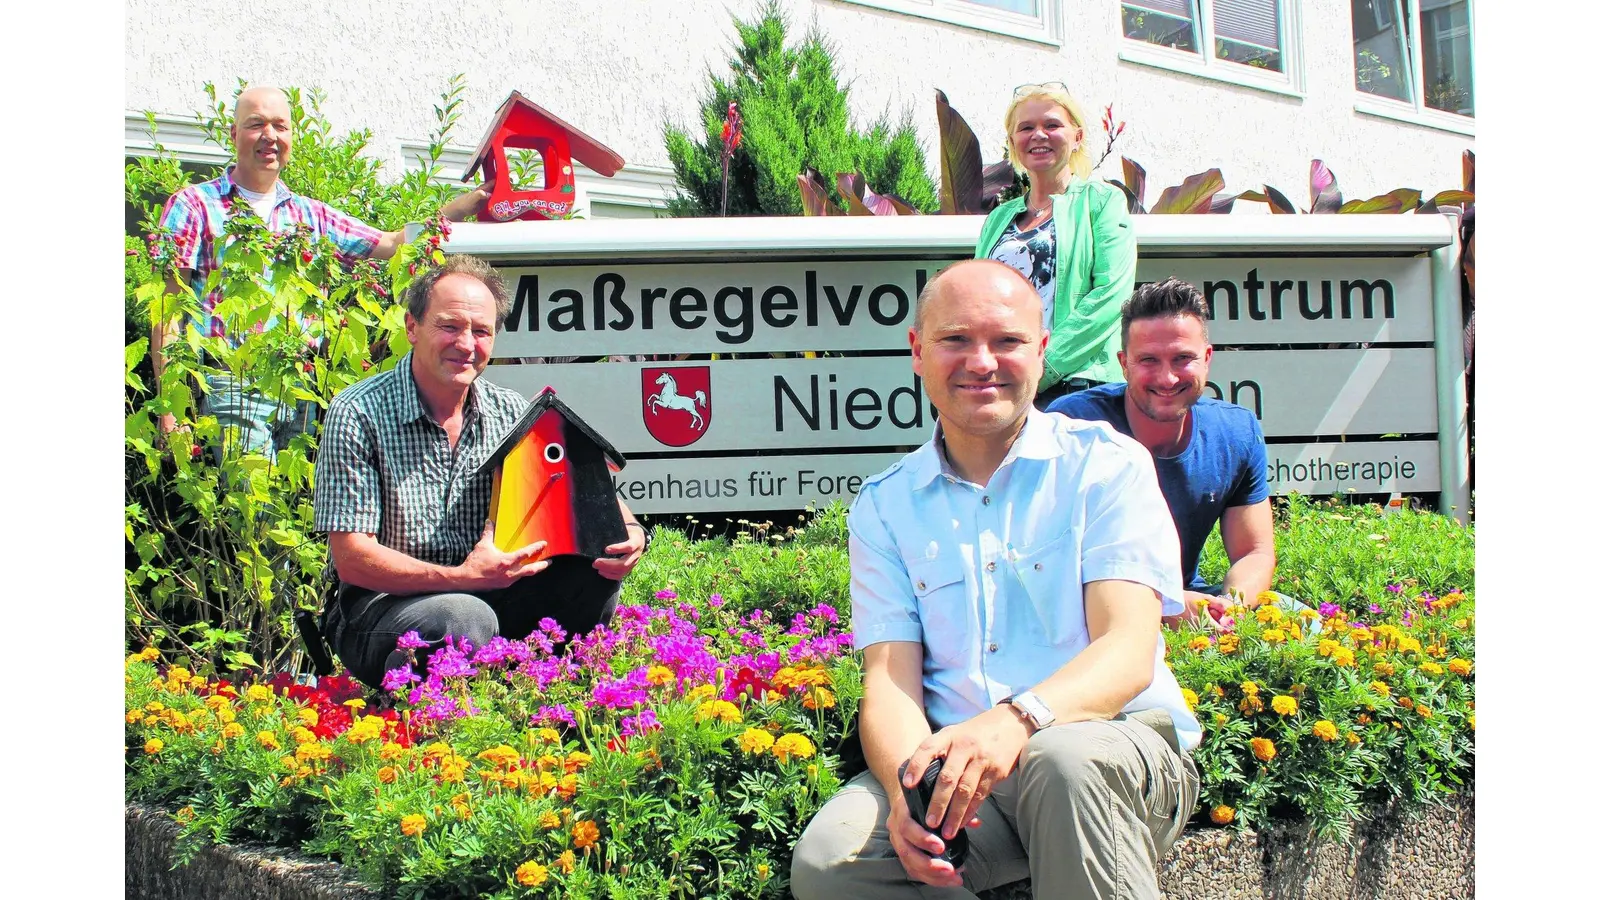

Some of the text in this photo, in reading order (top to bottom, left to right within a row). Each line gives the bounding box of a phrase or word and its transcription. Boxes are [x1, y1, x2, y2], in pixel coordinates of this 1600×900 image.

[512, 200, 530, 212] you
[549, 203, 567, 212] eat
[503, 269, 941, 343] Maßregelvo
[773, 373, 940, 432] Nied
[747, 471, 788, 497] für
[797, 470, 870, 496] Fore
